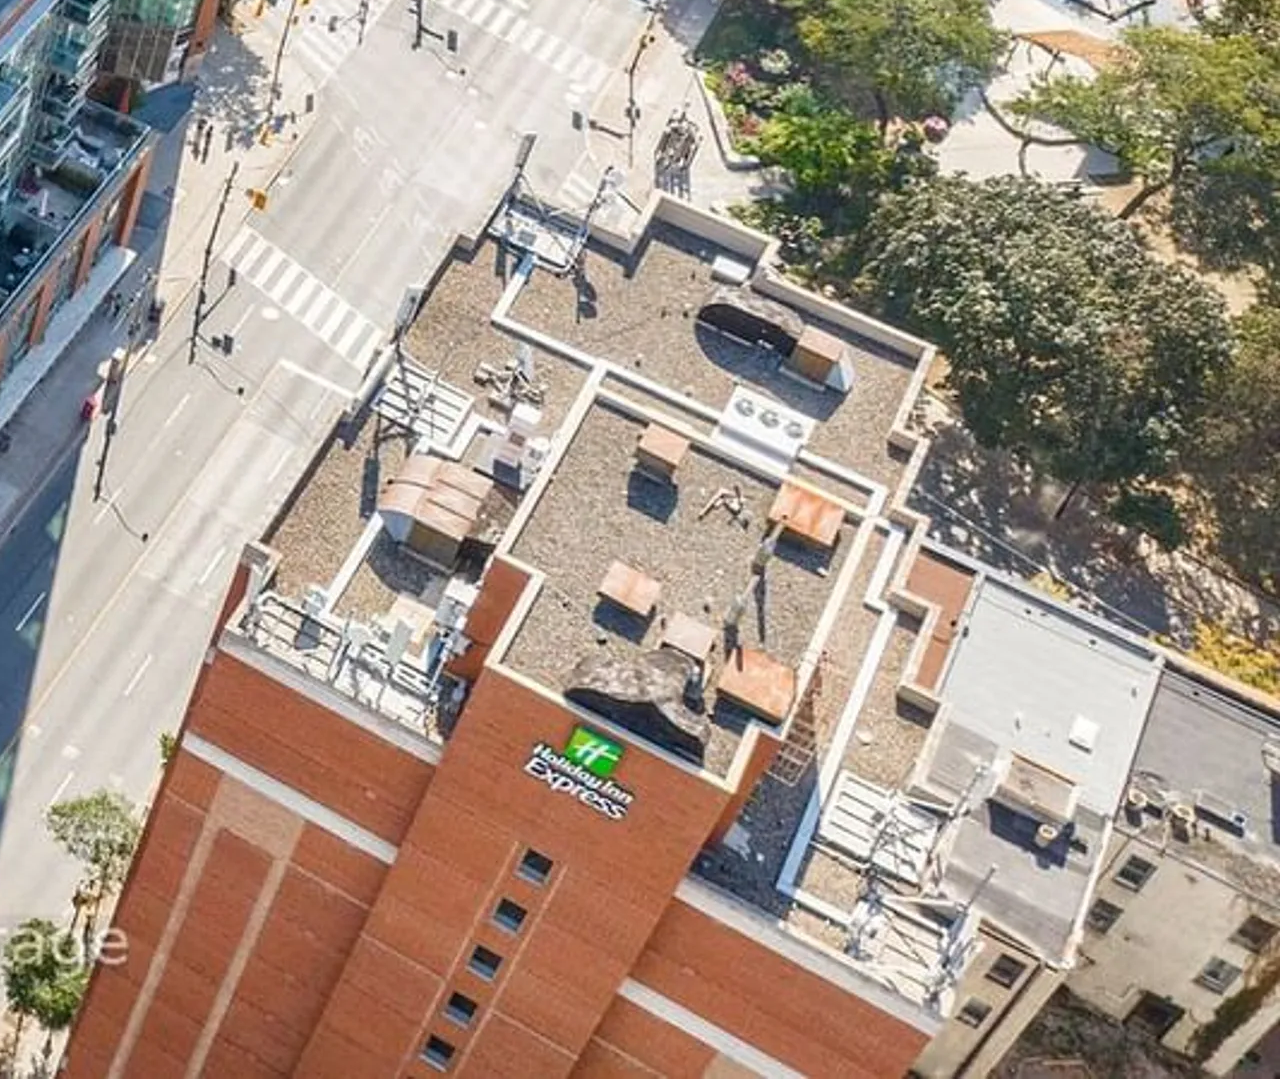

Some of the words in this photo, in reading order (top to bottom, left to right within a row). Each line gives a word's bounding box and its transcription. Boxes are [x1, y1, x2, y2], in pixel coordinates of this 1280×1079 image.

[524, 757, 627, 820] Express
[532, 743, 603, 790] Holiday
[600, 779, 635, 805] Inn
